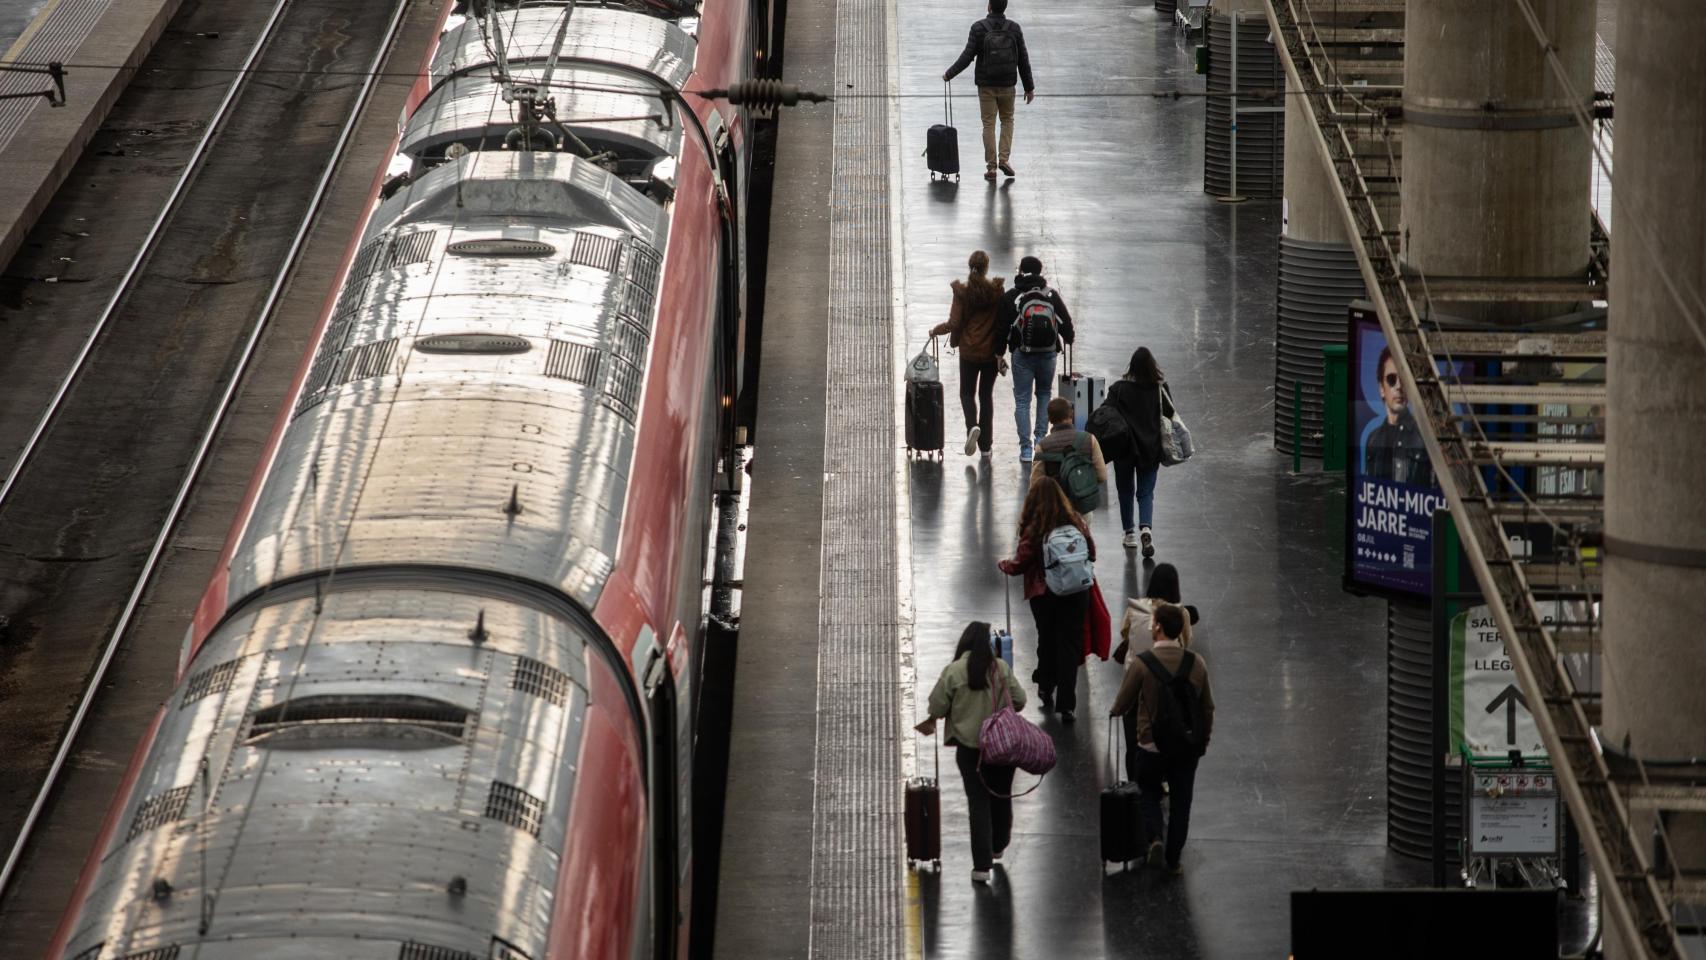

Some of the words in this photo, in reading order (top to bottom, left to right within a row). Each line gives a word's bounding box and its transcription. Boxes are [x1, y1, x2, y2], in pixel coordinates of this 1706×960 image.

[1358, 481, 1450, 517] JEAN-MICH
[1357, 505, 1408, 537] JARRE
[1471, 618, 1497, 628] SAL
[1475, 659, 1514, 671] LLEG
